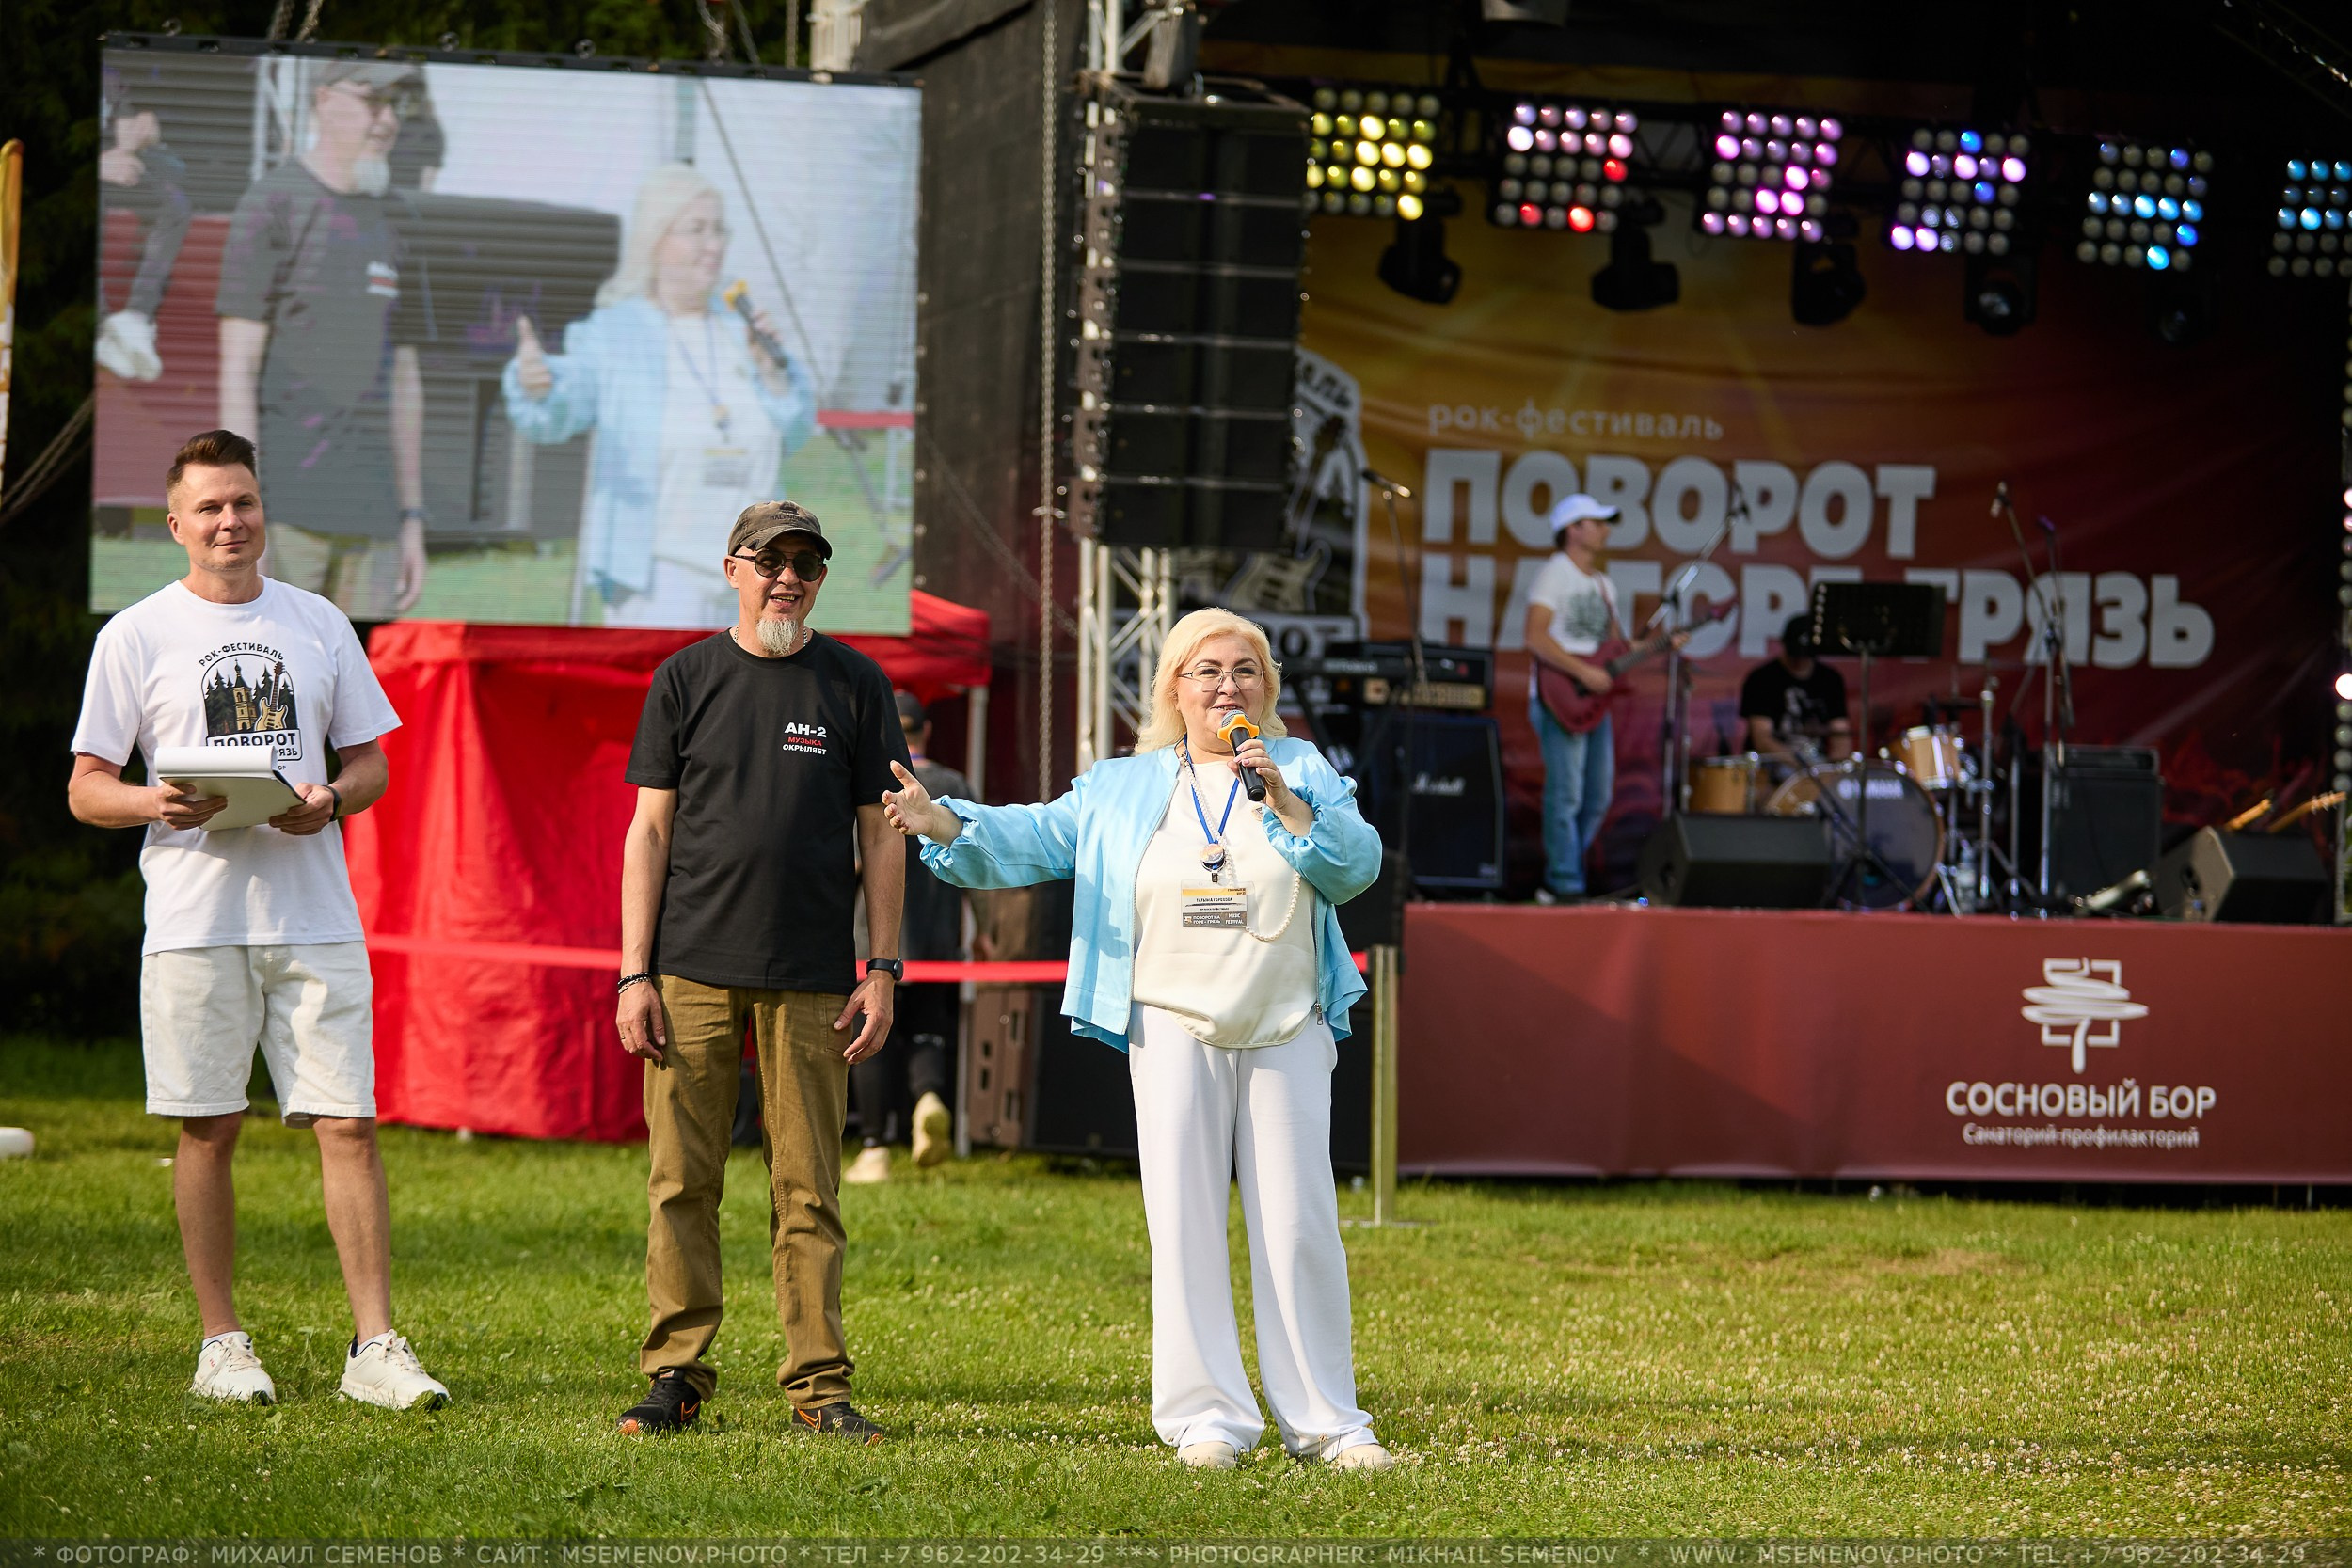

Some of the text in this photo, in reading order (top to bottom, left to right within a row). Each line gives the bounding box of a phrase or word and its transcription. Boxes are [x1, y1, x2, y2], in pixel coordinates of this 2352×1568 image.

[1428, 403, 1724, 441] рок-фестиваль
[1422, 447, 1937, 560] ПОВОРОТ
[1604, 559, 1863, 660] ГОР
[199, 642, 284, 666] РОК-ФЕСТИВАЛЬ
[784, 721, 827, 738] АН-2
[787, 736, 822, 747] МУЗЫКА
[278, 748, 297, 756] ЯЗЬ
[782, 744, 827, 755] ОКРЫЛЯЕТ
[1946, 1078, 2217, 1119] СОСНОВЫЙ БОР
